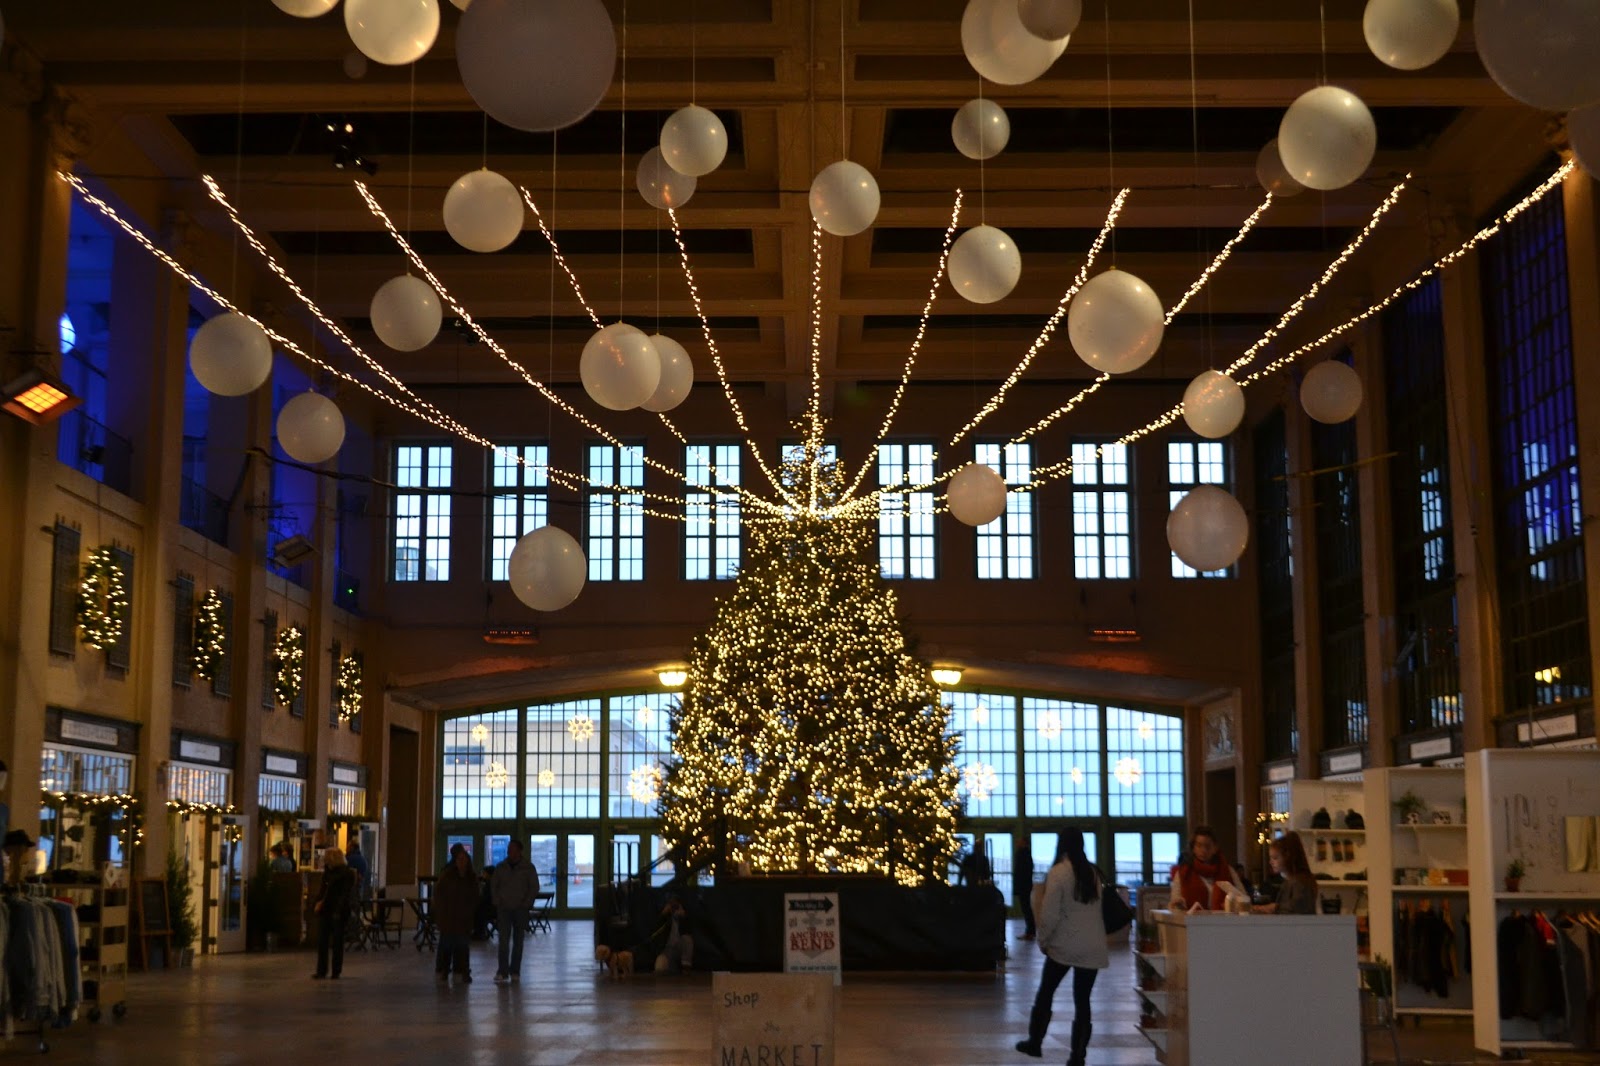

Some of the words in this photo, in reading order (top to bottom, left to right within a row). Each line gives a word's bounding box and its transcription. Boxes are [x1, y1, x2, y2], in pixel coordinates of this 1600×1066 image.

[791, 938, 835, 951] BEND
[723, 991, 759, 1008] Shop
[721, 1043, 823, 1066] MARKET
